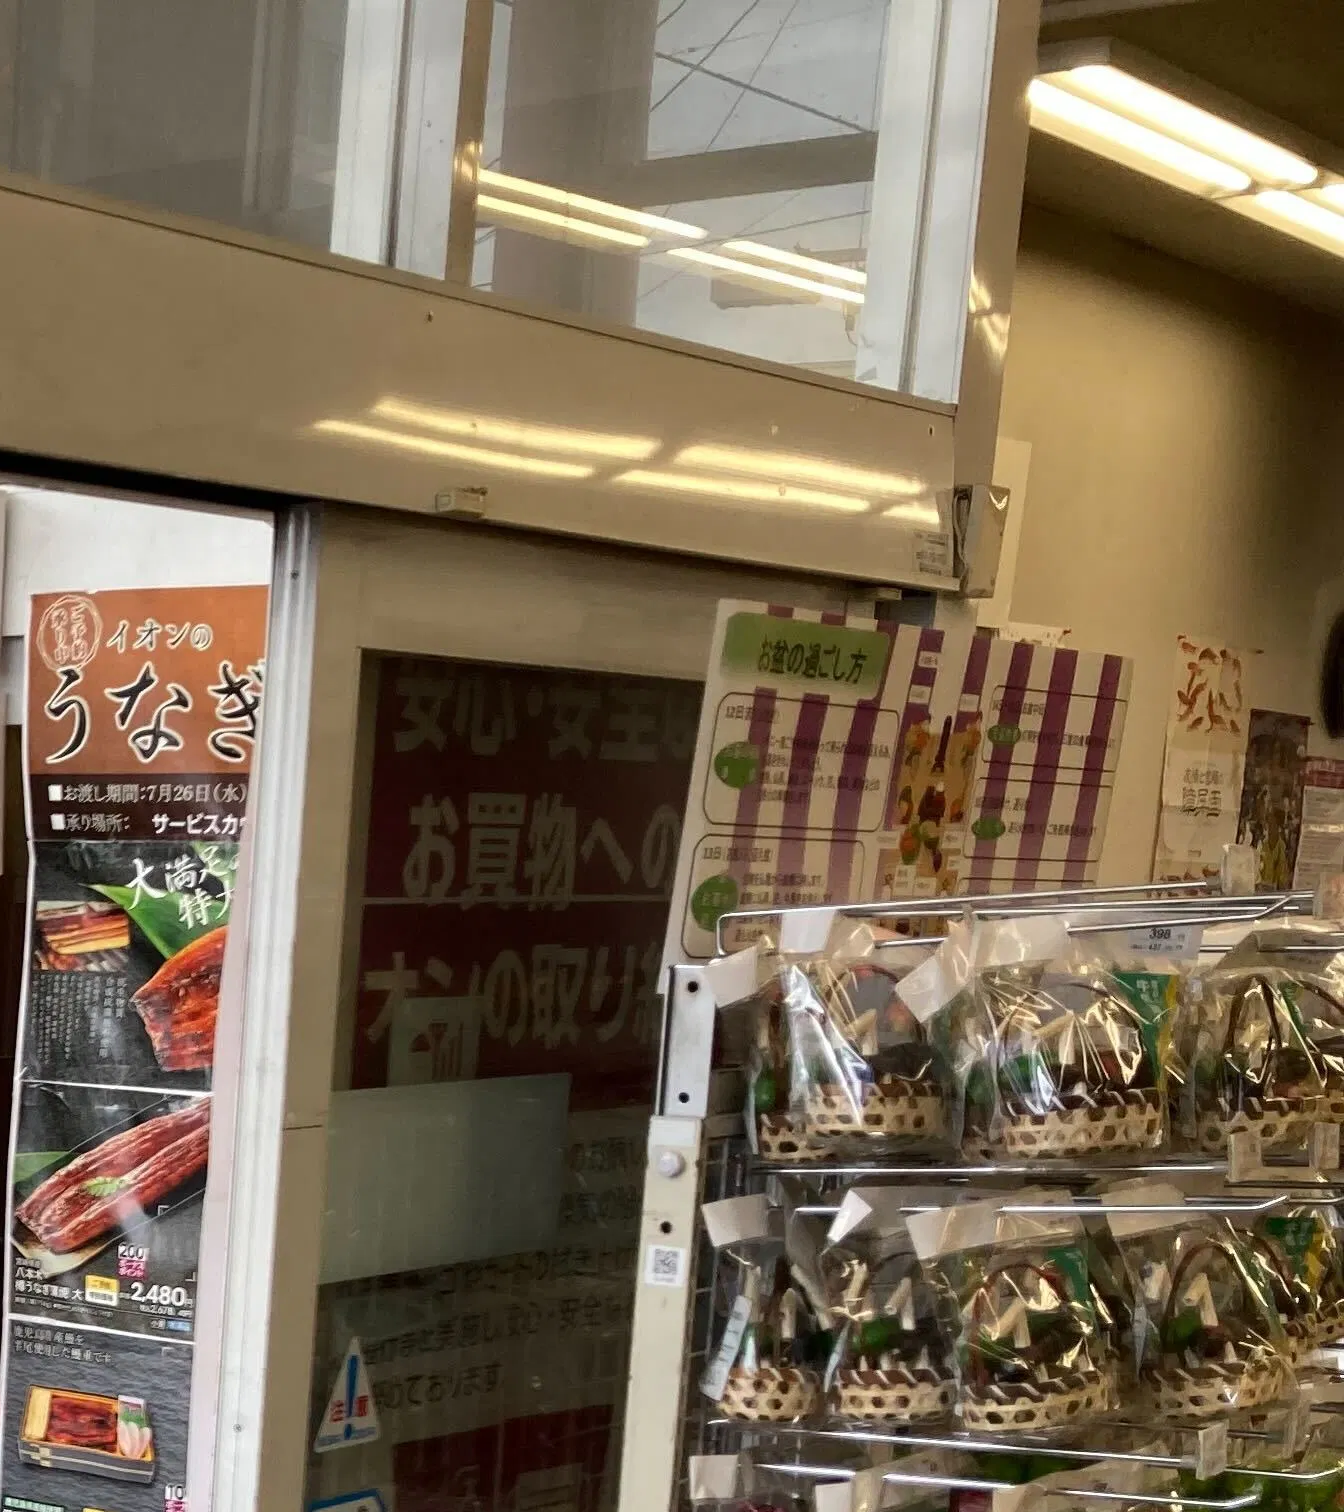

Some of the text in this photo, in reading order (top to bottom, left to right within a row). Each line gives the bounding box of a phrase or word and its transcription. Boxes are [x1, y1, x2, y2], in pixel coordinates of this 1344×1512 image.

[106, 618, 212, 653] イオンの
[757, 634, 867, 685] お盆の過ごし方
[44, 659, 265, 765] うなぎ
[1148, 928, 1171, 940] 398
